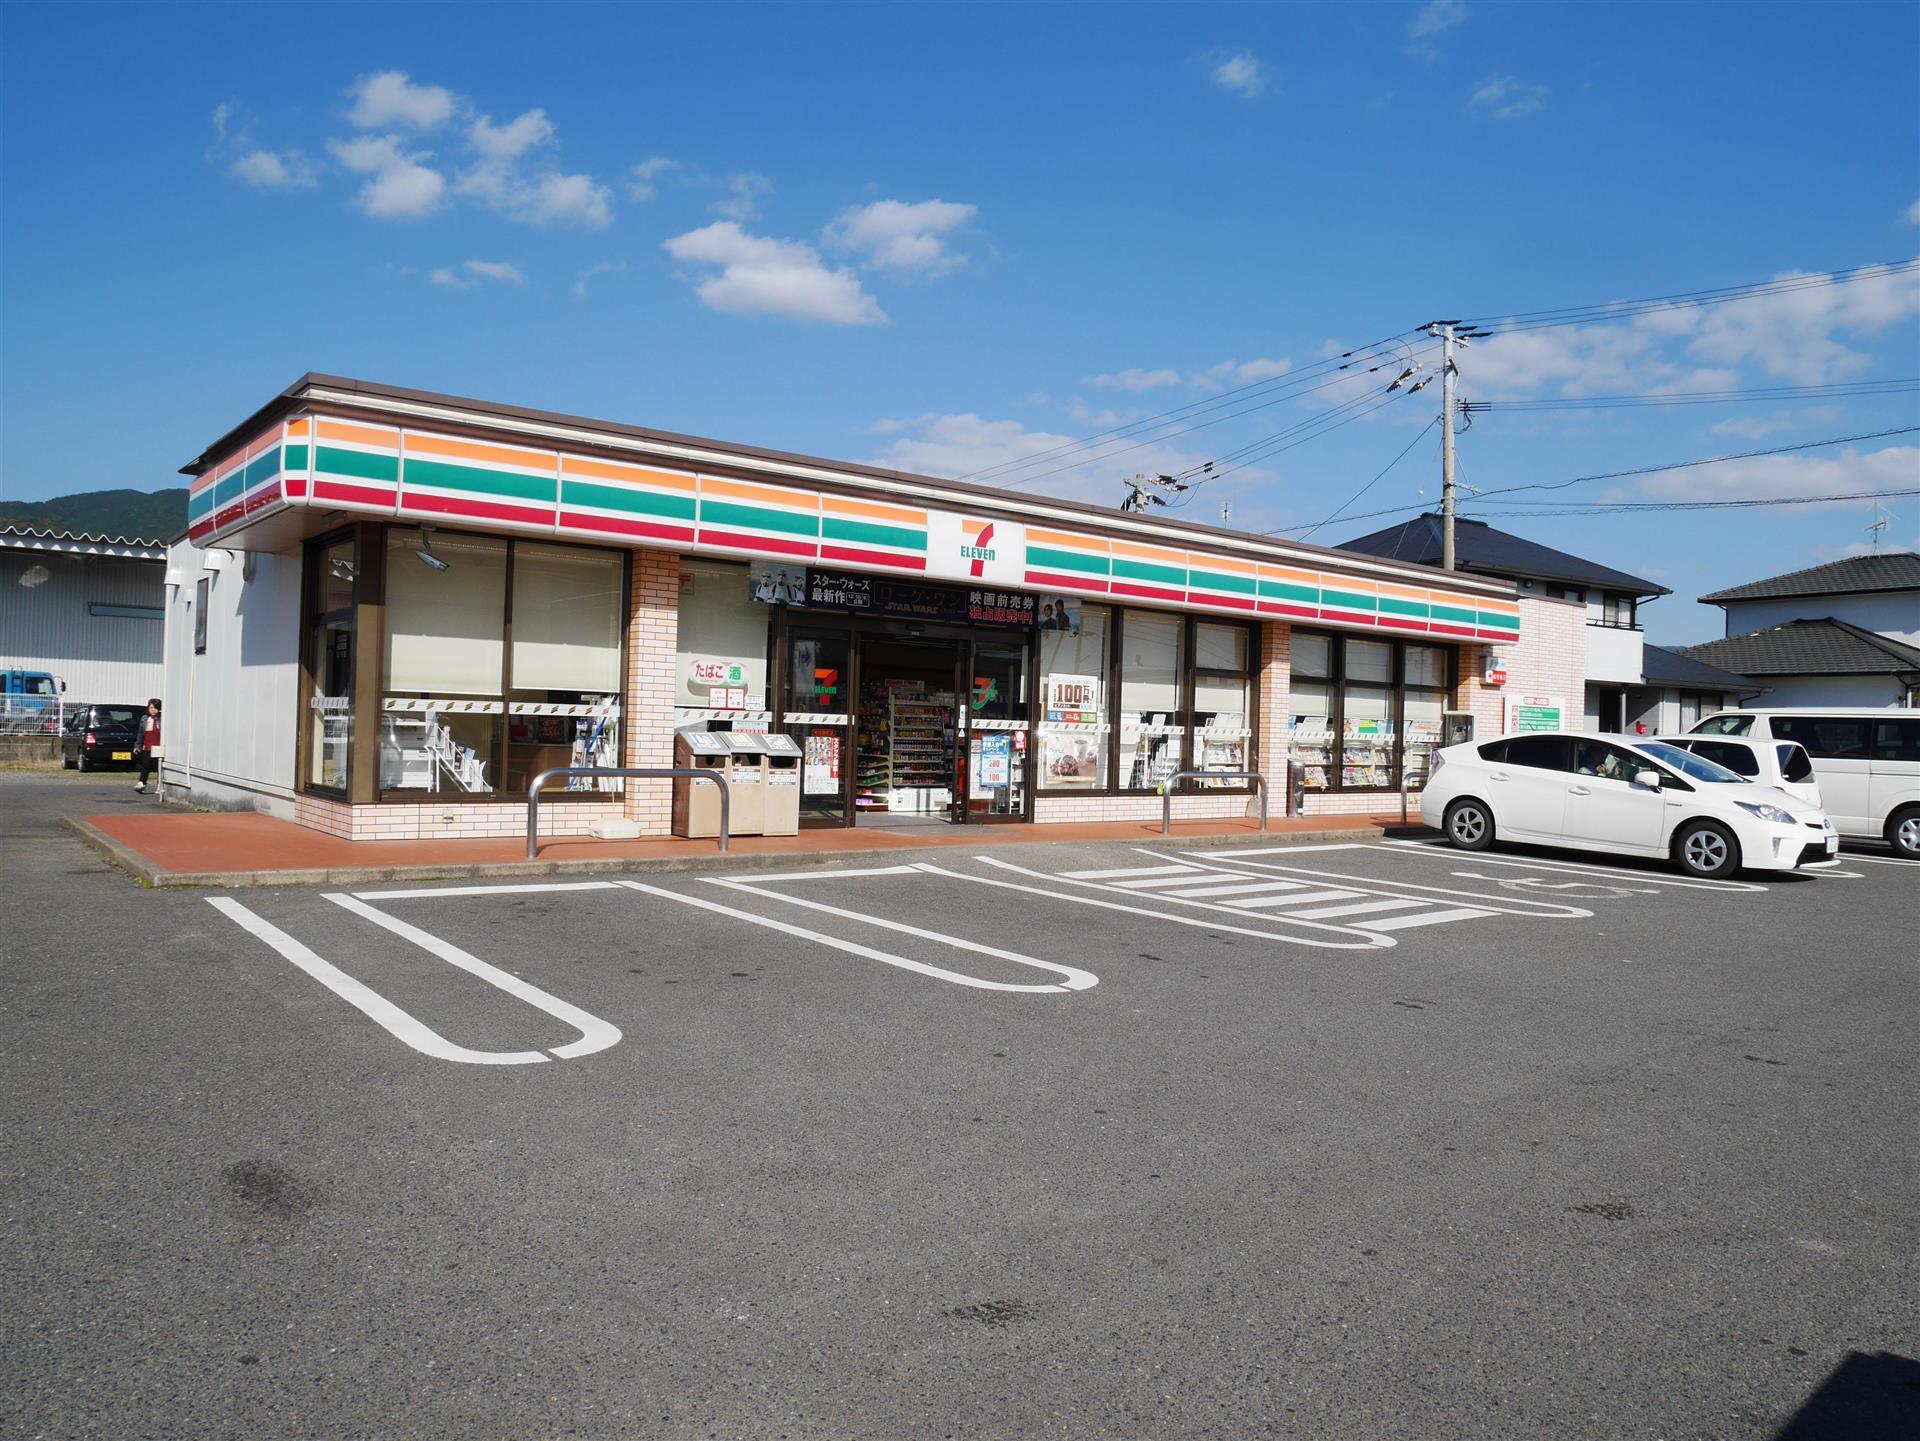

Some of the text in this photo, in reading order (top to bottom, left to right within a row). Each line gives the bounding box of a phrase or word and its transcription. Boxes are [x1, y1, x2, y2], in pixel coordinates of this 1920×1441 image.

[962, 519, 994, 577] 7
[812, 574, 870, 590] スター・ウォーズ
[811, 587, 846, 604] 最新作
[970, 591, 1034, 610] 映画前売券
[695, 663, 742, 681] たばこ 酒
